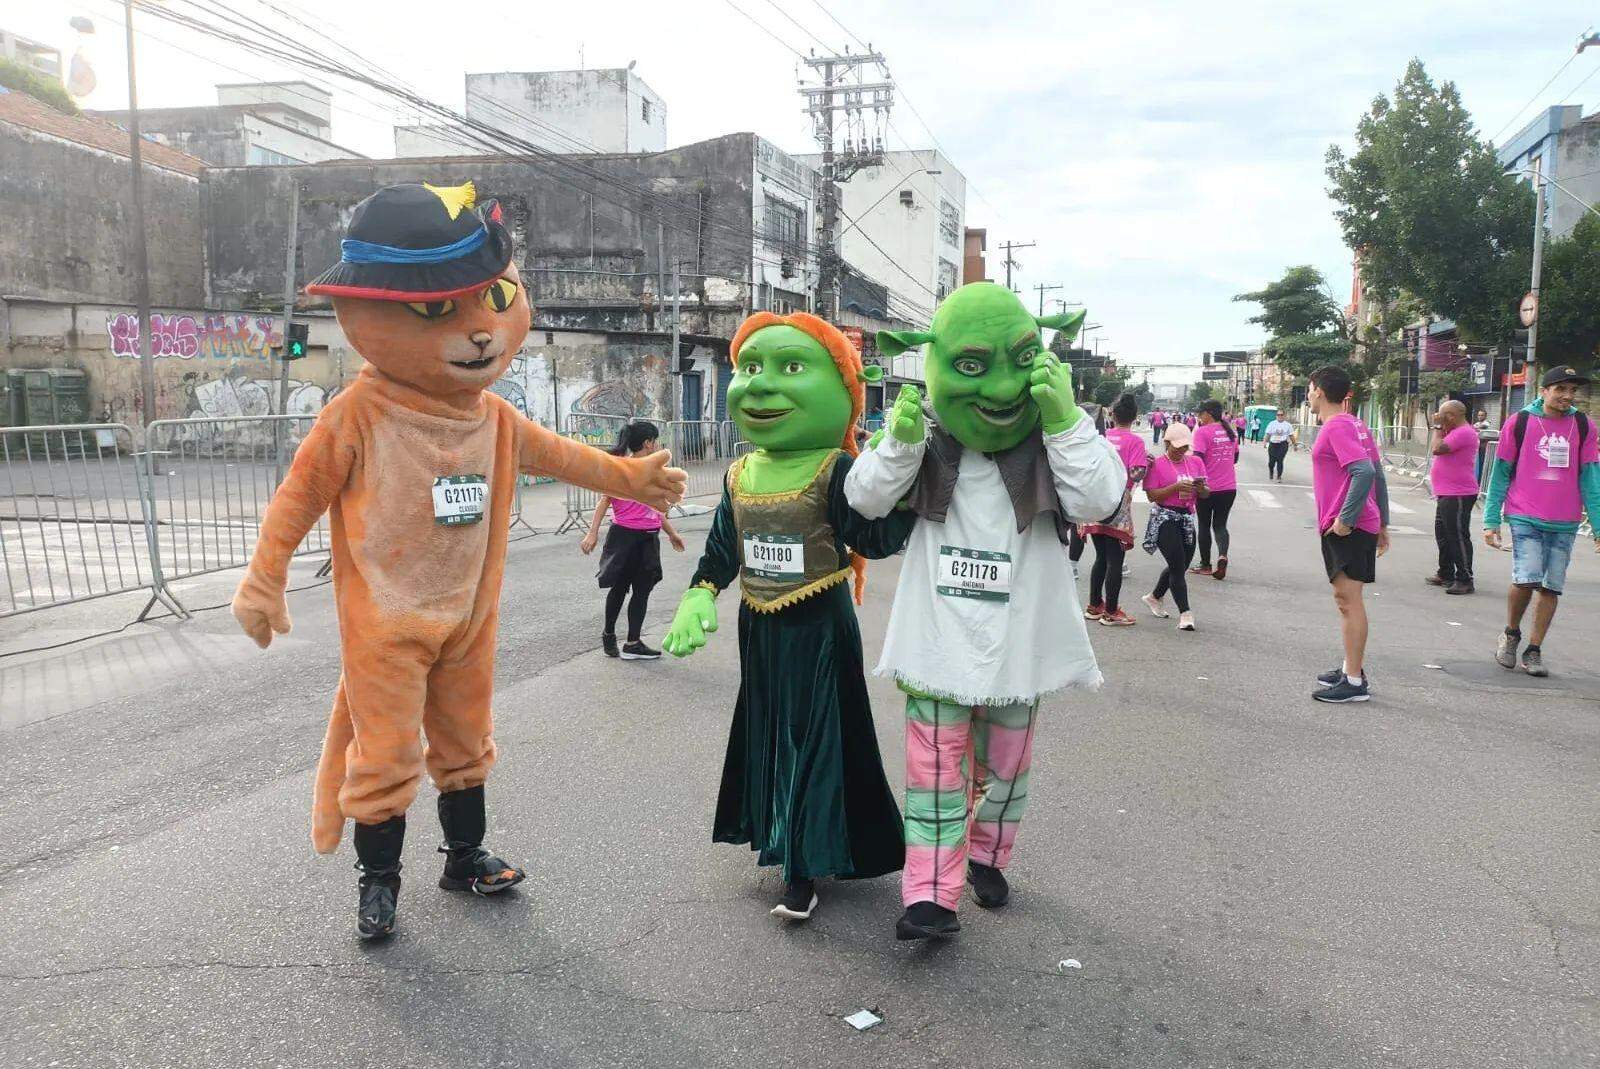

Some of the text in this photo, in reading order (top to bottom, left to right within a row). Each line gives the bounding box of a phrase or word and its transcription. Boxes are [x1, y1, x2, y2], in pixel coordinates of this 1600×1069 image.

[445, 487, 483, 503] G21179
[753, 545, 792, 562] G21180
[951, 560, 998, 581] G21178
